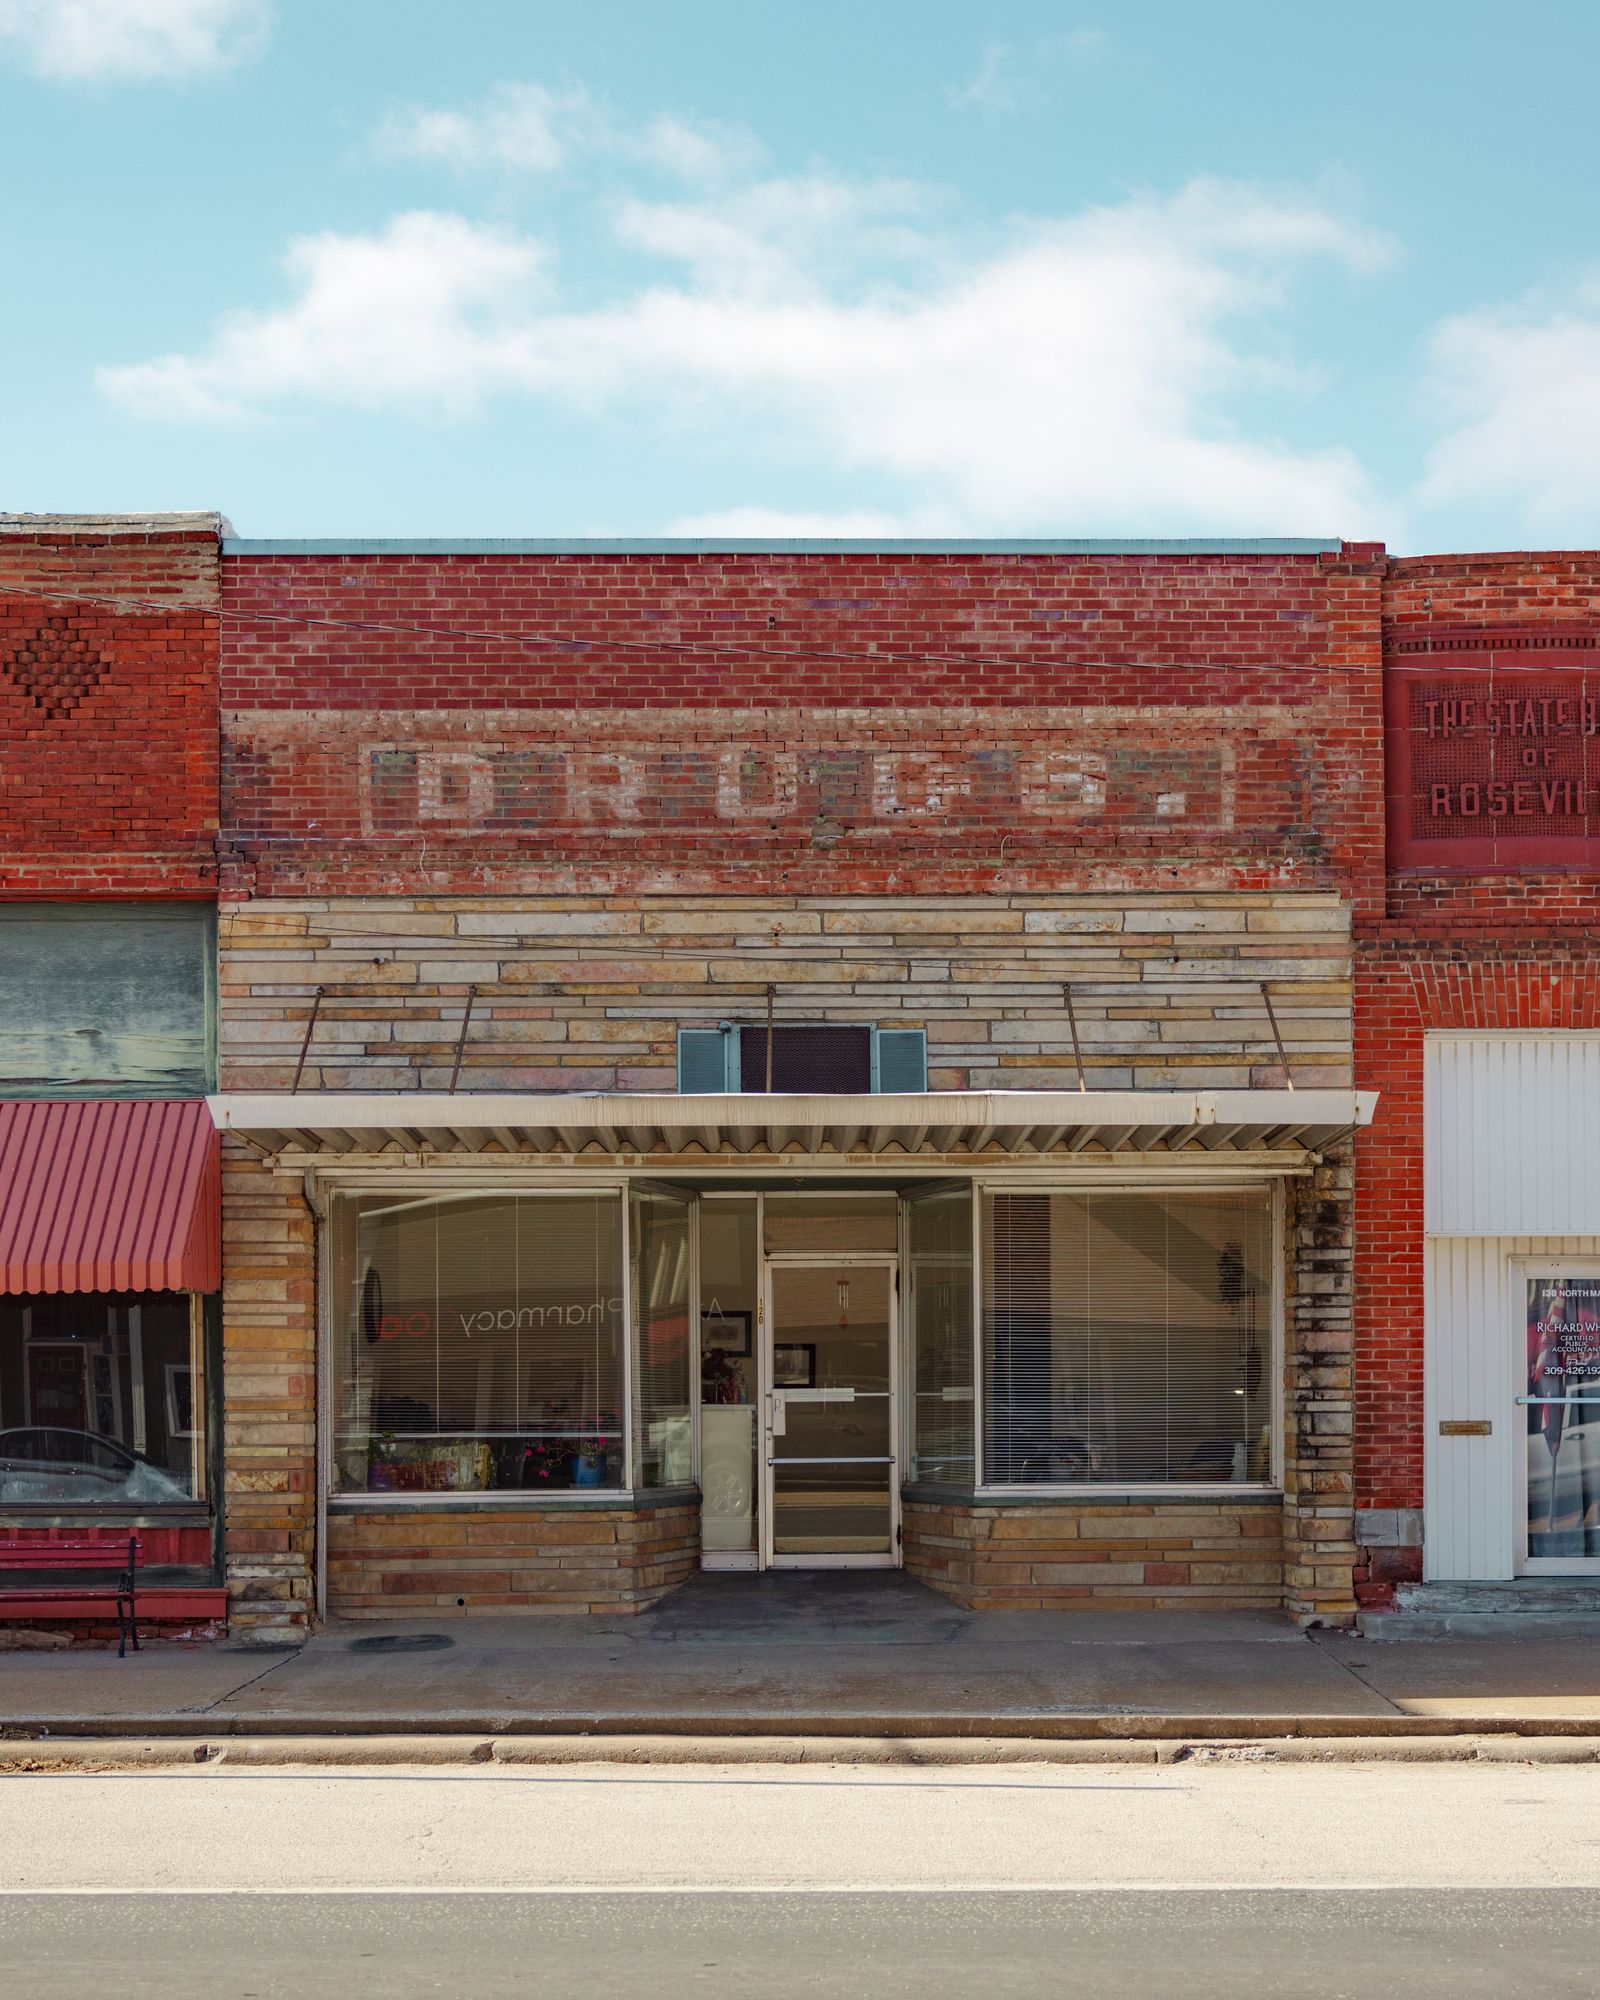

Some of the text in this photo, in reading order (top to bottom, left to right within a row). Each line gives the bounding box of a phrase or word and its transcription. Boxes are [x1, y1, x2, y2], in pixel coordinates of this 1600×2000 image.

[1425, 700, 1476, 738] THE
[1486, 698, 1570, 738] STATE
[1522, 748, 1557, 767] OF
[1560, 1289, 1589, 1298] NORTH
[1537, 1321, 1584, 1333] RICHARD
